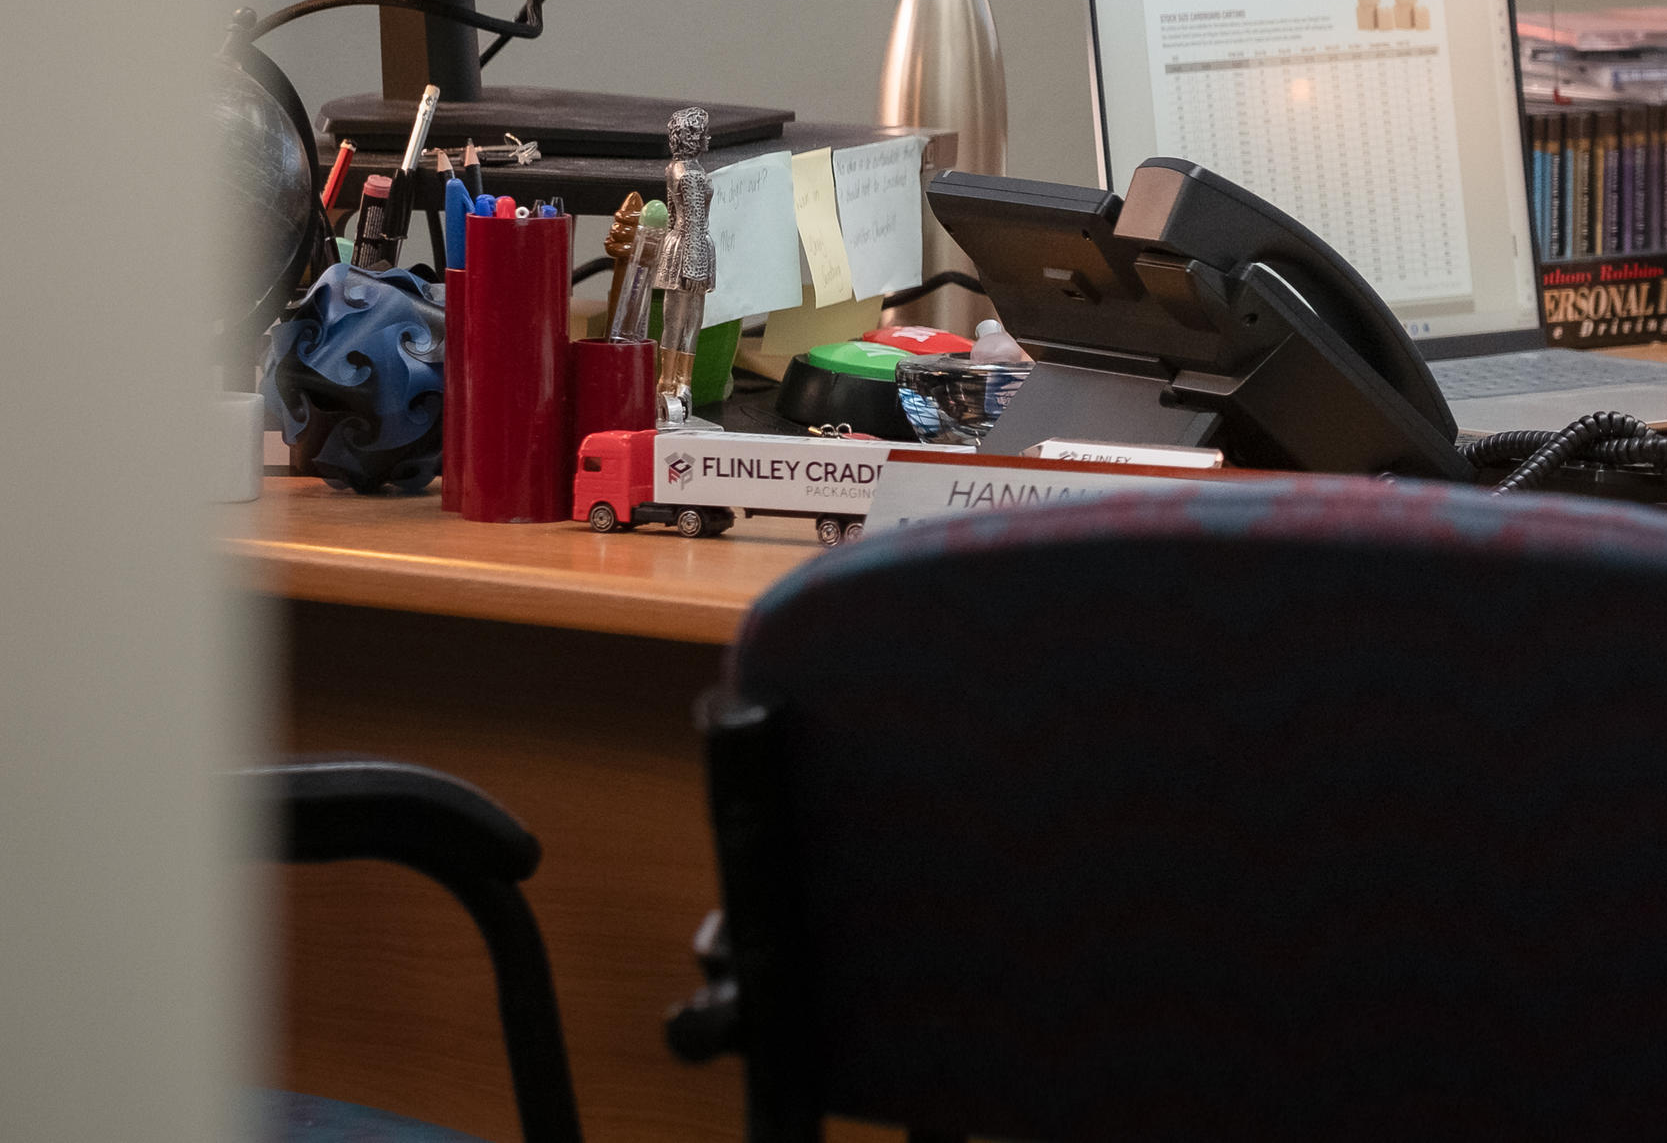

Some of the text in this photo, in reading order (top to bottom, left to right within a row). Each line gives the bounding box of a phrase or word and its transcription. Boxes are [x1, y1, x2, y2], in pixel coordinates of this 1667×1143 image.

[1543, 263, 1664, 287] nthony Robbins
[1543, 282, 1655, 323] ERSONAL
[702, 456, 801, 481] FLINLEY
